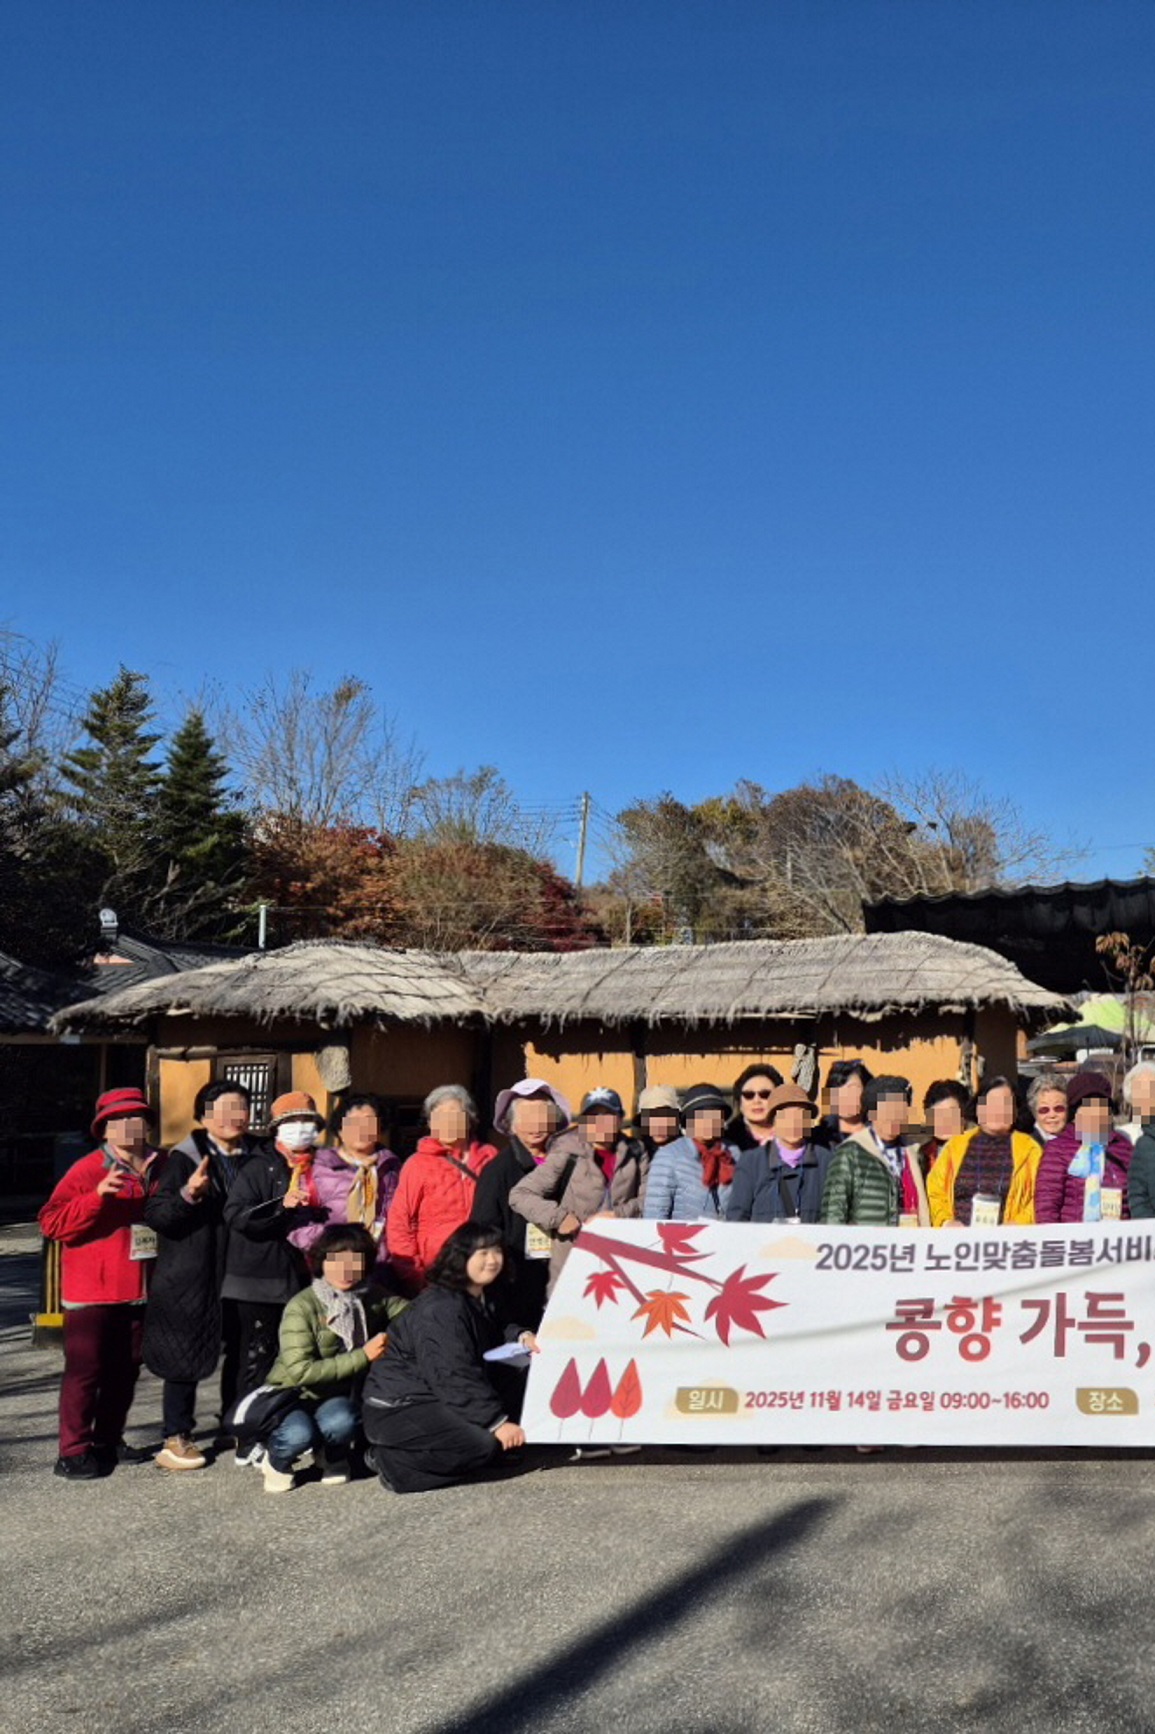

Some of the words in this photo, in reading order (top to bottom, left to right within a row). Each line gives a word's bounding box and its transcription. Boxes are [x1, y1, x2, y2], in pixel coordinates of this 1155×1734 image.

[816, 1242, 915, 1273] 2025년
[886, 1296, 1002, 1362] 콩향
[1019, 1292, 1152, 1368] 가득,
[688, 1391, 723, 1411] 일시
[745, 1392, 805, 1410] 2025년
[811, 1391, 842, 1412] 11월
[848, 1391, 882, 1412] 14일
[887, 1391, 935, 1412] 금요일
[940, 1392, 1050, 1411] 09:00~16:00
[1088, 1392, 1124, 1412] 장소
